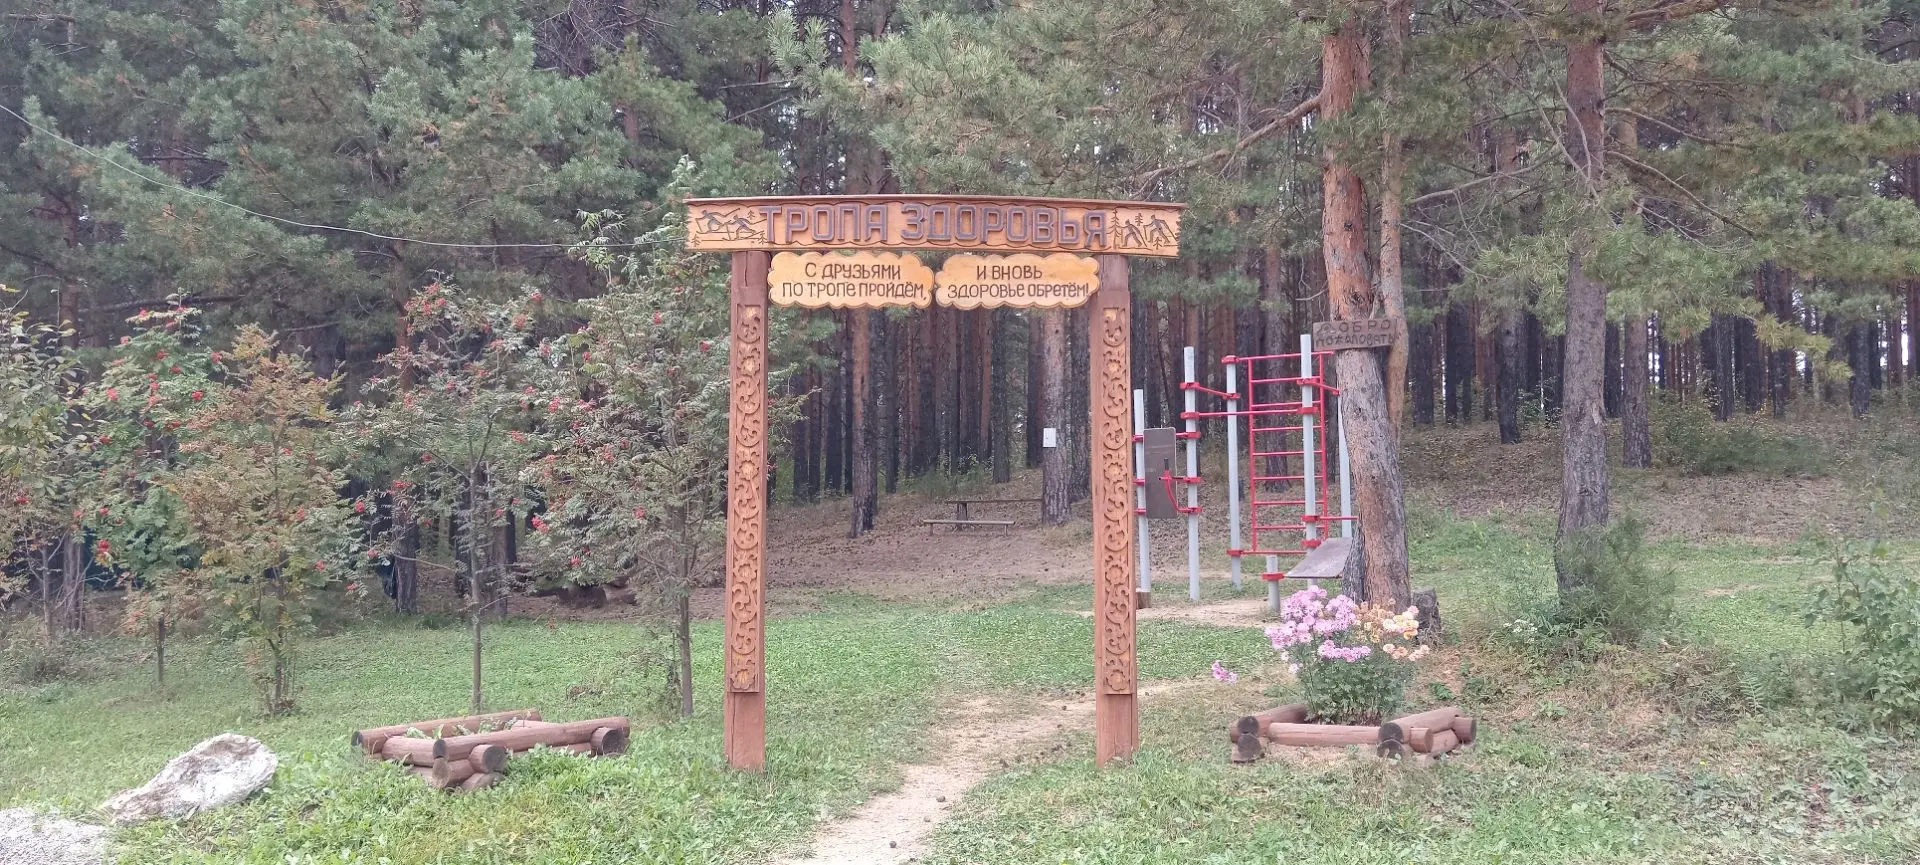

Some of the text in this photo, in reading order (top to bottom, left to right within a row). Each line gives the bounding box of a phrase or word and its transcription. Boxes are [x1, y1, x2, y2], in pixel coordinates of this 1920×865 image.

[759, 204, 1107, 247] ТРОПА ЗДОРОВЬЯ
[821, 263, 901, 281] ДРУЗЬЯМИ
[991, 265, 1043, 280] ВНОВЬ
[782, 282, 804, 298] ПО
